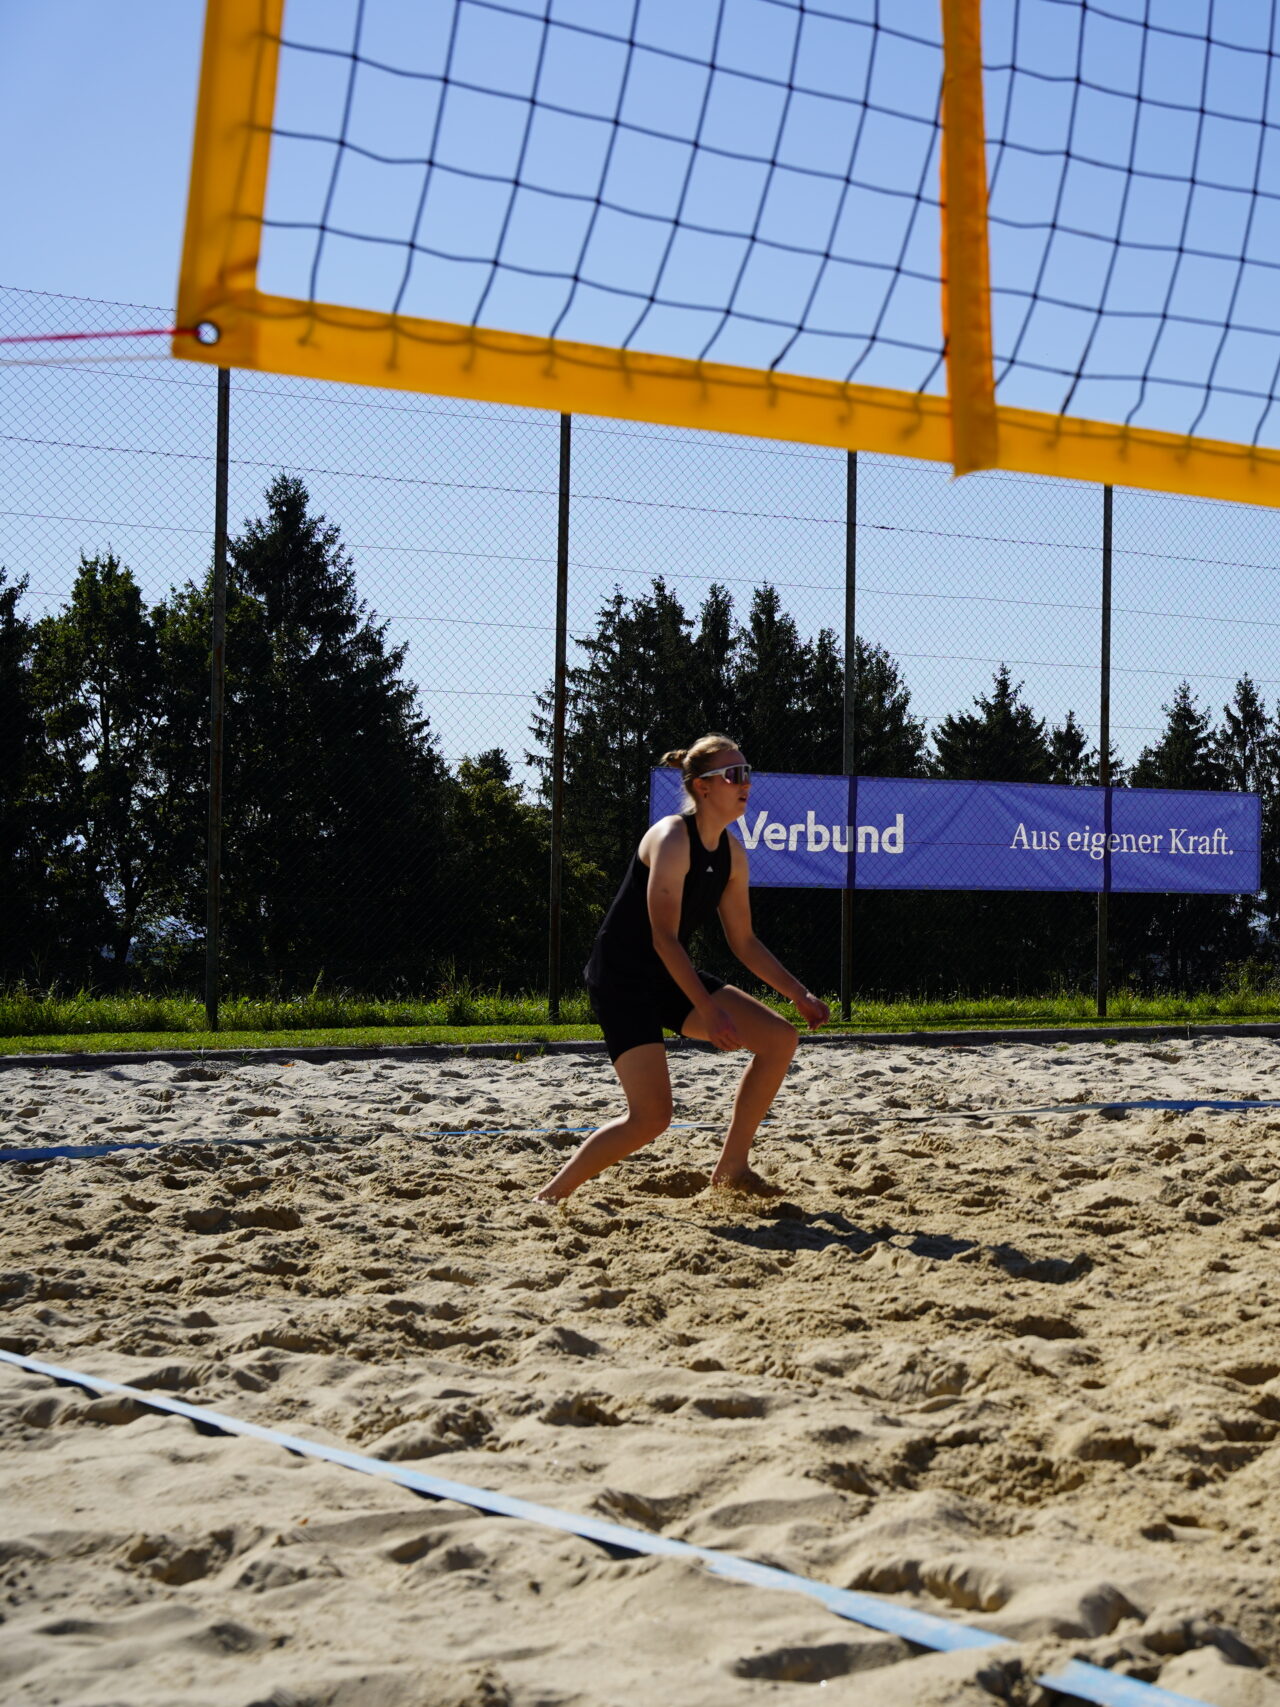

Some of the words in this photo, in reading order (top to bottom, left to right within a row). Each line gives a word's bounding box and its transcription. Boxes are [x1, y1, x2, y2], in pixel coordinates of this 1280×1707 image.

[736, 810, 904, 854] Verbund
[1010, 822, 1060, 850] Aus
[1067, 825, 1163, 860] eigener
[1168, 827, 1234, 855] Kraft.
